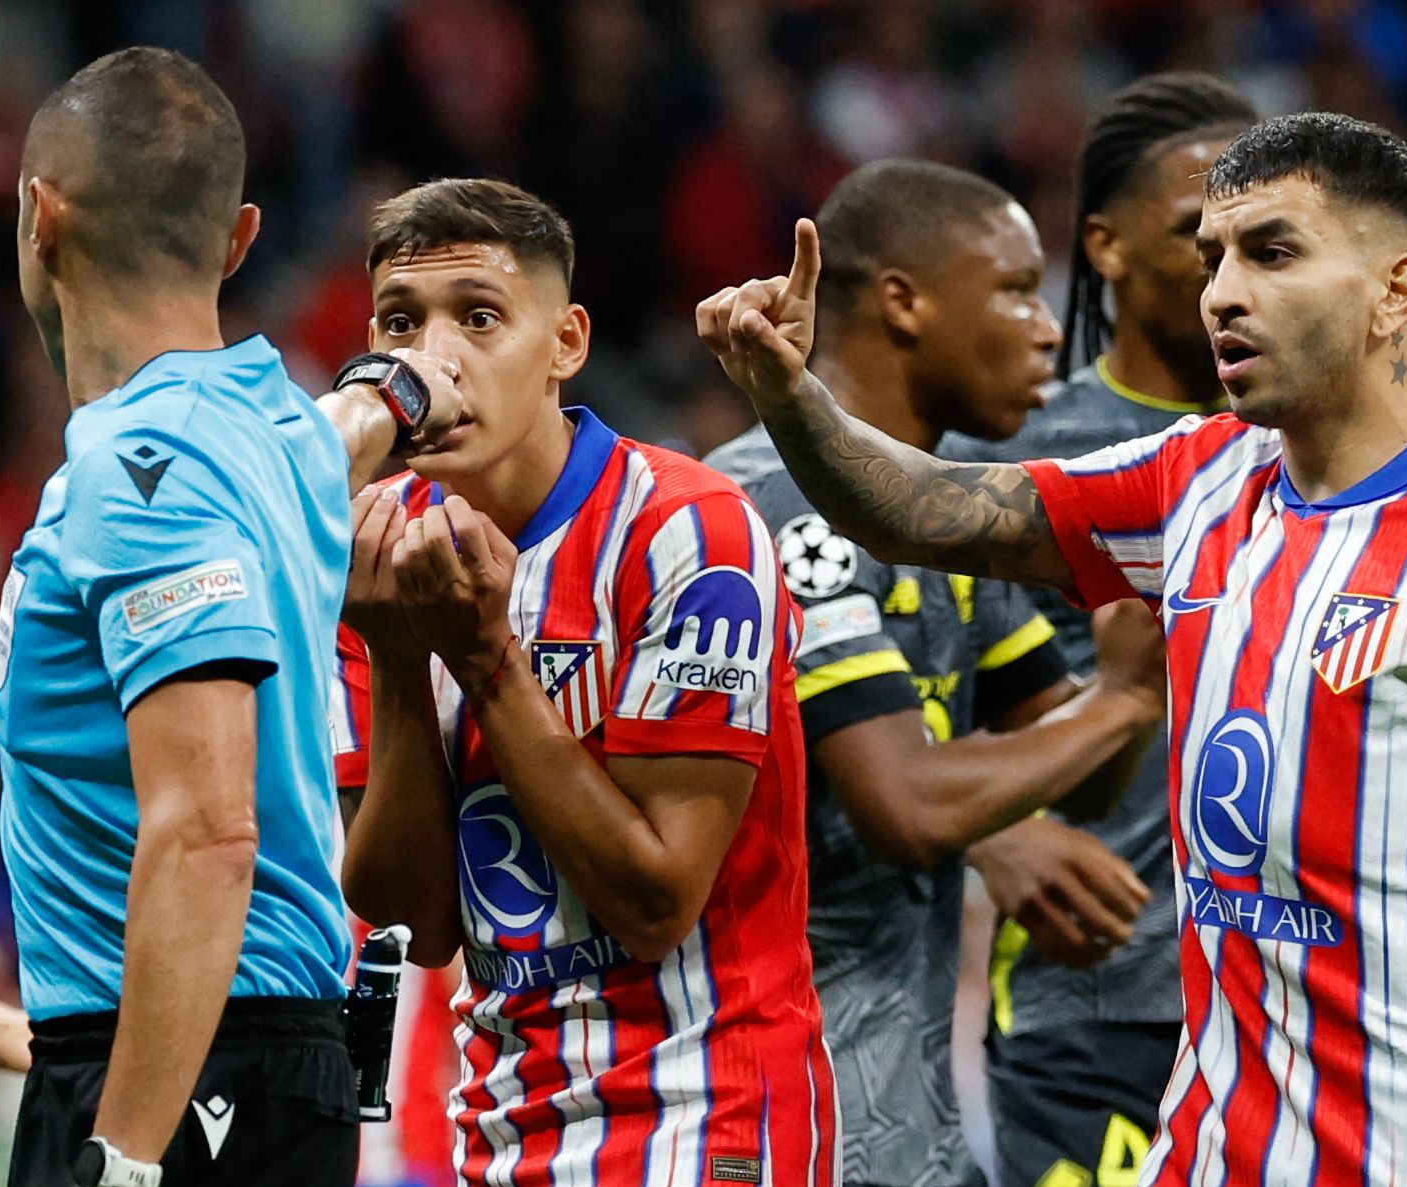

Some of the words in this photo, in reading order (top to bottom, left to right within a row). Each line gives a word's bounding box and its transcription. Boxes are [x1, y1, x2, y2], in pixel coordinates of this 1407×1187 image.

[127, 572, 242, 619] FOUNDATION
[656, 658, 757, 692] kraken
[1186, 881, 1264, 934] YADH
[1271, 904, 1337, 943] AIR
